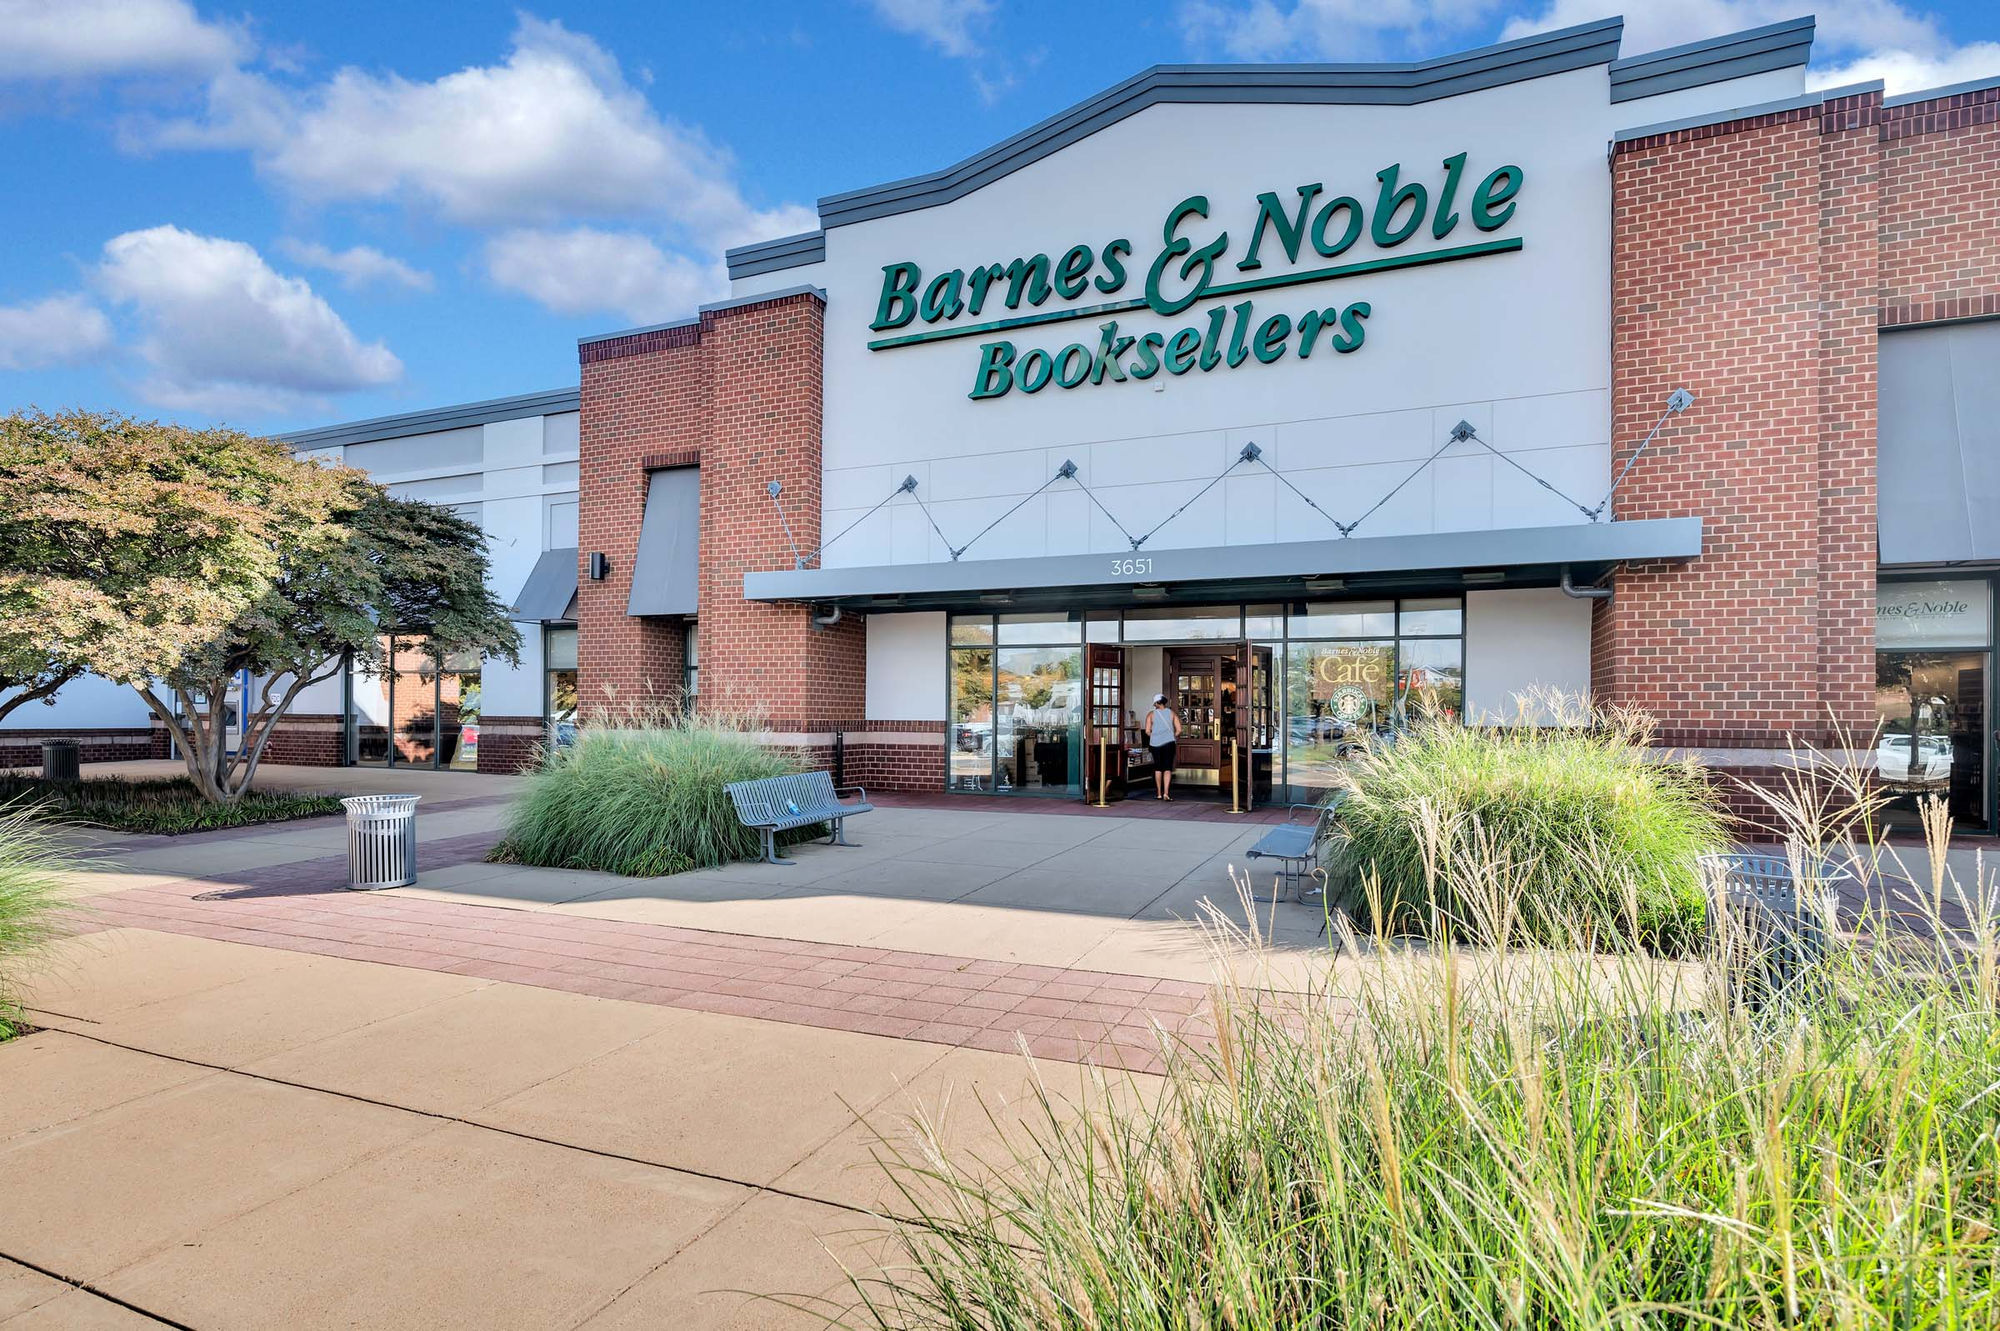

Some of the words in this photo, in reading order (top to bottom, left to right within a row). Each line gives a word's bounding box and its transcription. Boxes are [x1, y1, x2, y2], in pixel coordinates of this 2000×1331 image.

[868, 238, 1133, 332] Barnes
[1144, 195, 1228, 317] &
[1236, 151, 1524, 272] Noble
[968, 301, 1371, 400] Booksellers
[1111, 558, 1152, 575] 3651
[1876, 604, 1903, 615] nes
[1904, 601, 1919, 618] &
[1921, 600, 1968, 614] Noble
[1320, 656, 1380, 683] Café
